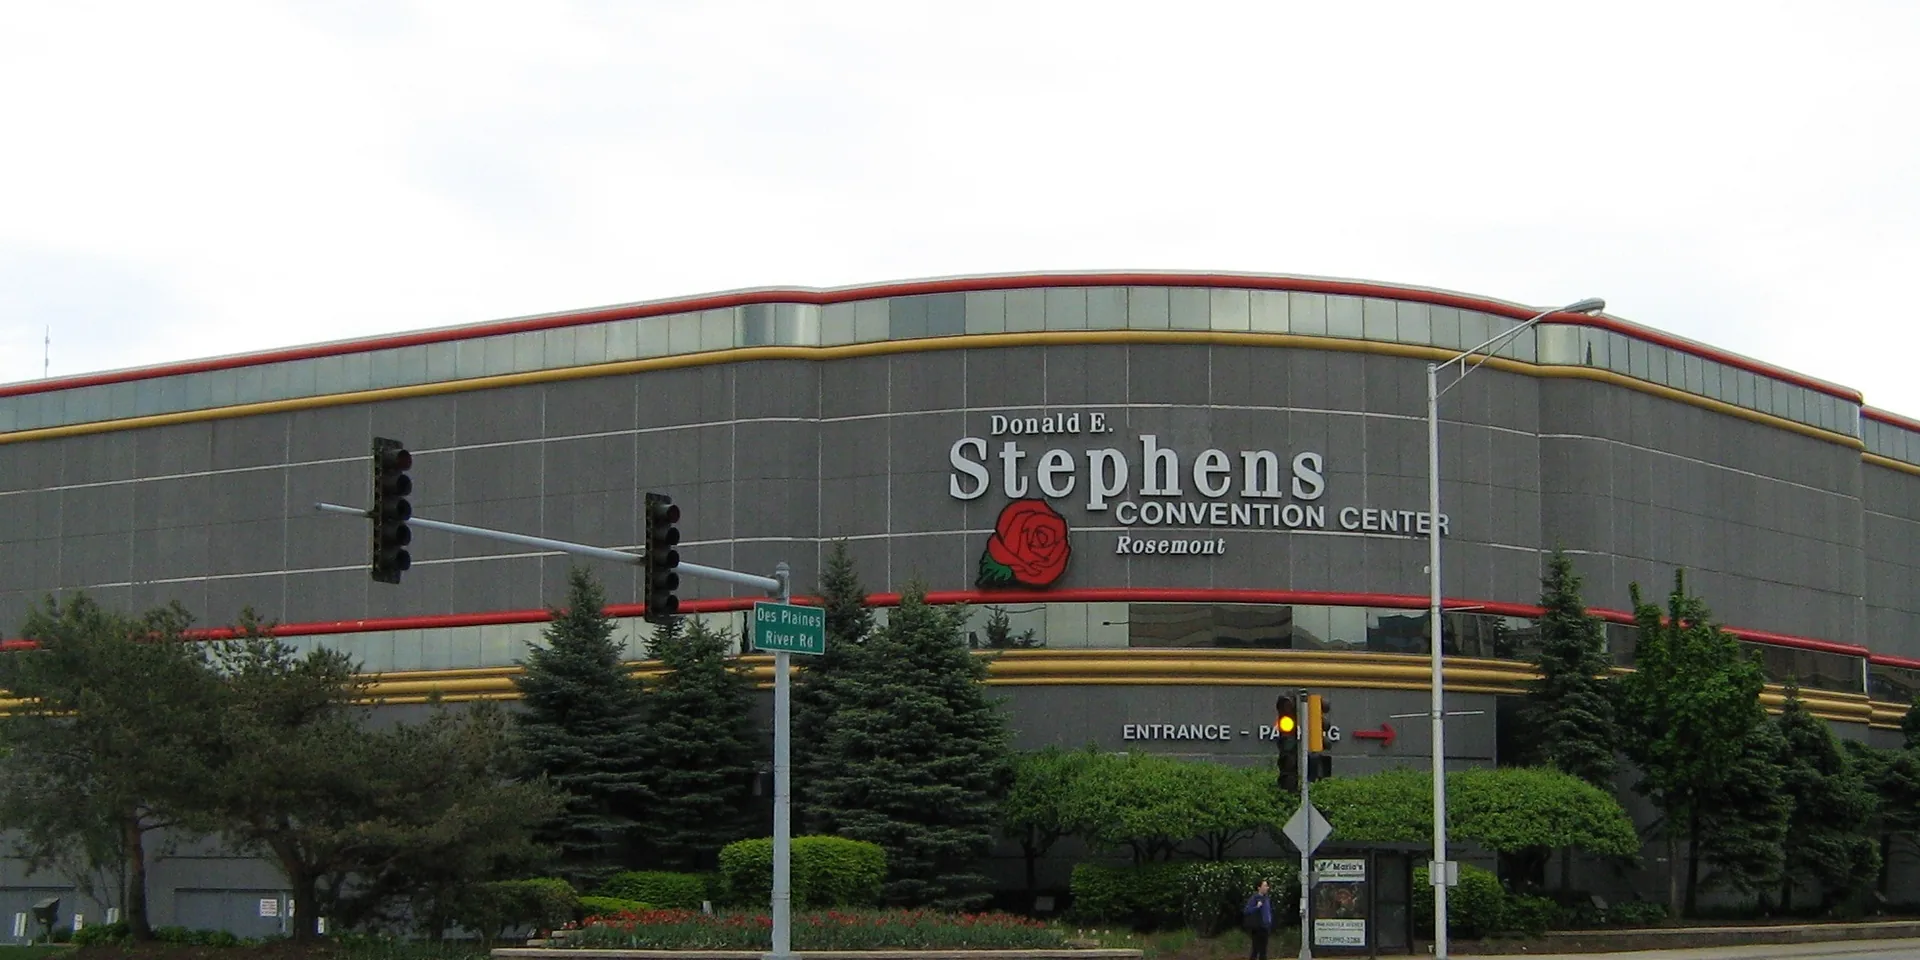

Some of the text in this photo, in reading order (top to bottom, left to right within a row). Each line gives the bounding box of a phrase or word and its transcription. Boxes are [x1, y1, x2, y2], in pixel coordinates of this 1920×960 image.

[991, 413, 1114, 435] Donald E.
[949, 434, 1326, 511] Stephens
[1115, 501, 1450, 535] CONVENTION CENTER
[1115, 535, 1226, 555] Rosemont
[757, 607, 821, 627] Des Plaines
[765, 630, 814, 648] River Rd
[1123, 724, 1231, 741] ENTRANCE
